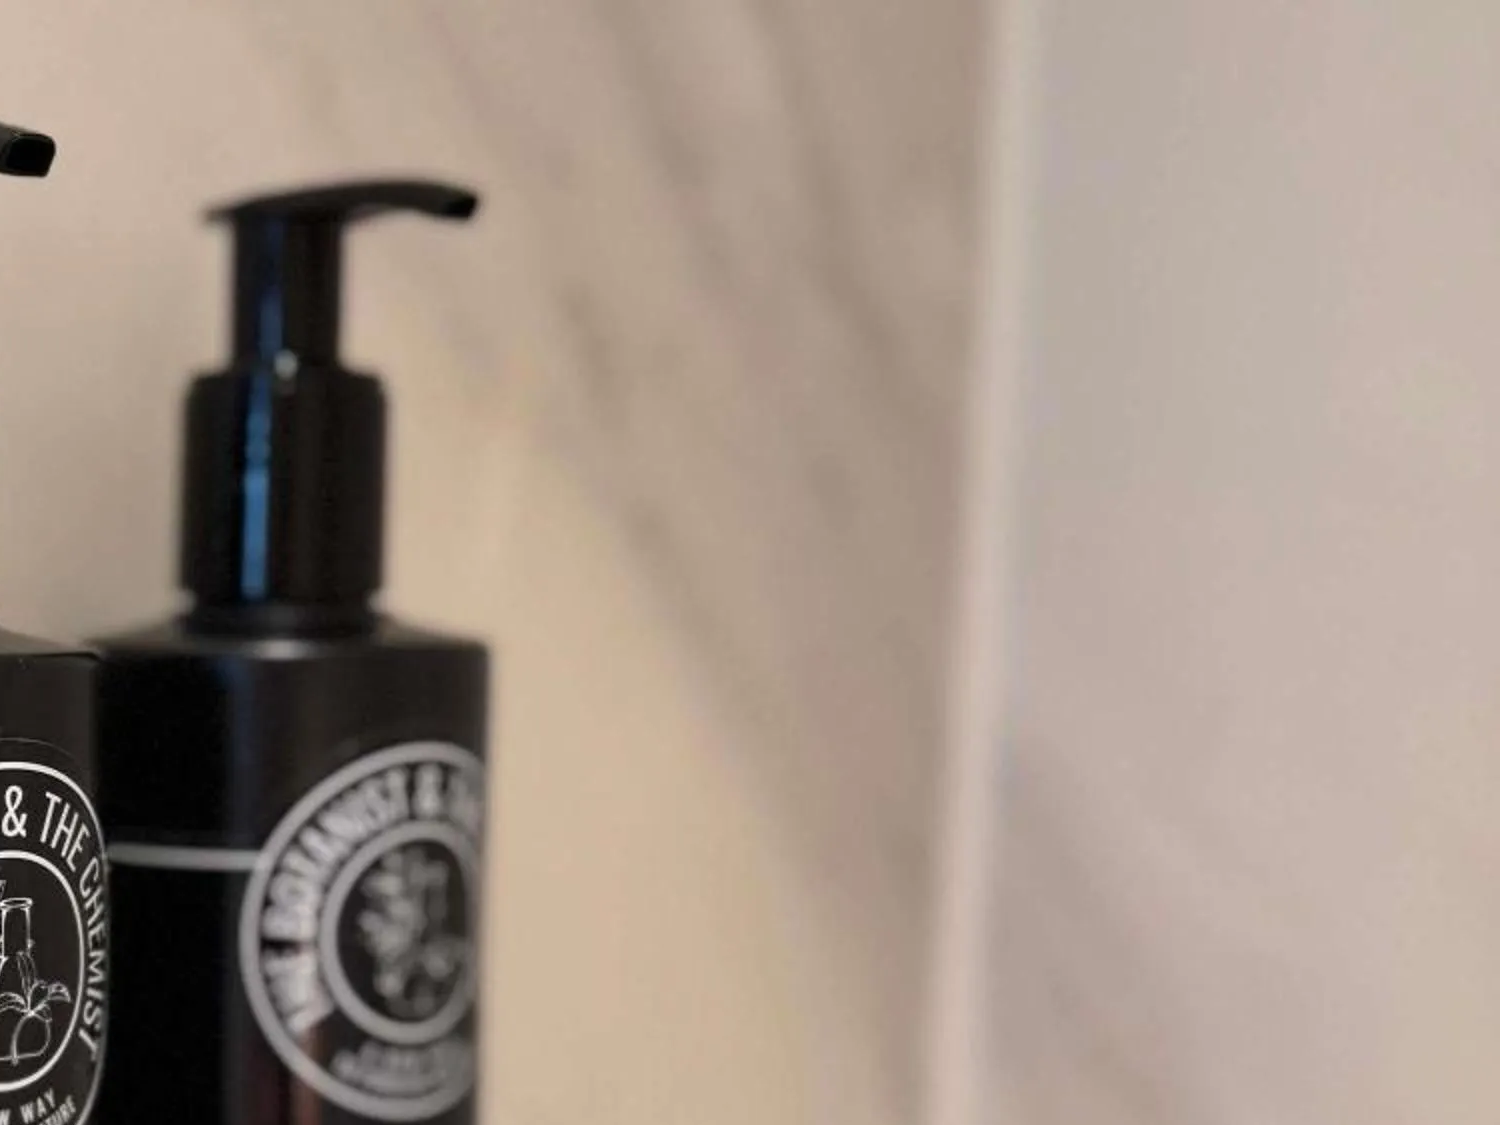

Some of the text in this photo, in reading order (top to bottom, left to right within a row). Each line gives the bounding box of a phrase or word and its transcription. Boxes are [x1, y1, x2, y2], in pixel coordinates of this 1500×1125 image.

[1, 785, 28, 838] &
[40, 791, 91, 873] THE
[78, 856, 106, 1061] CHEMIST
[20, 1088, 56, 1125] WAY
